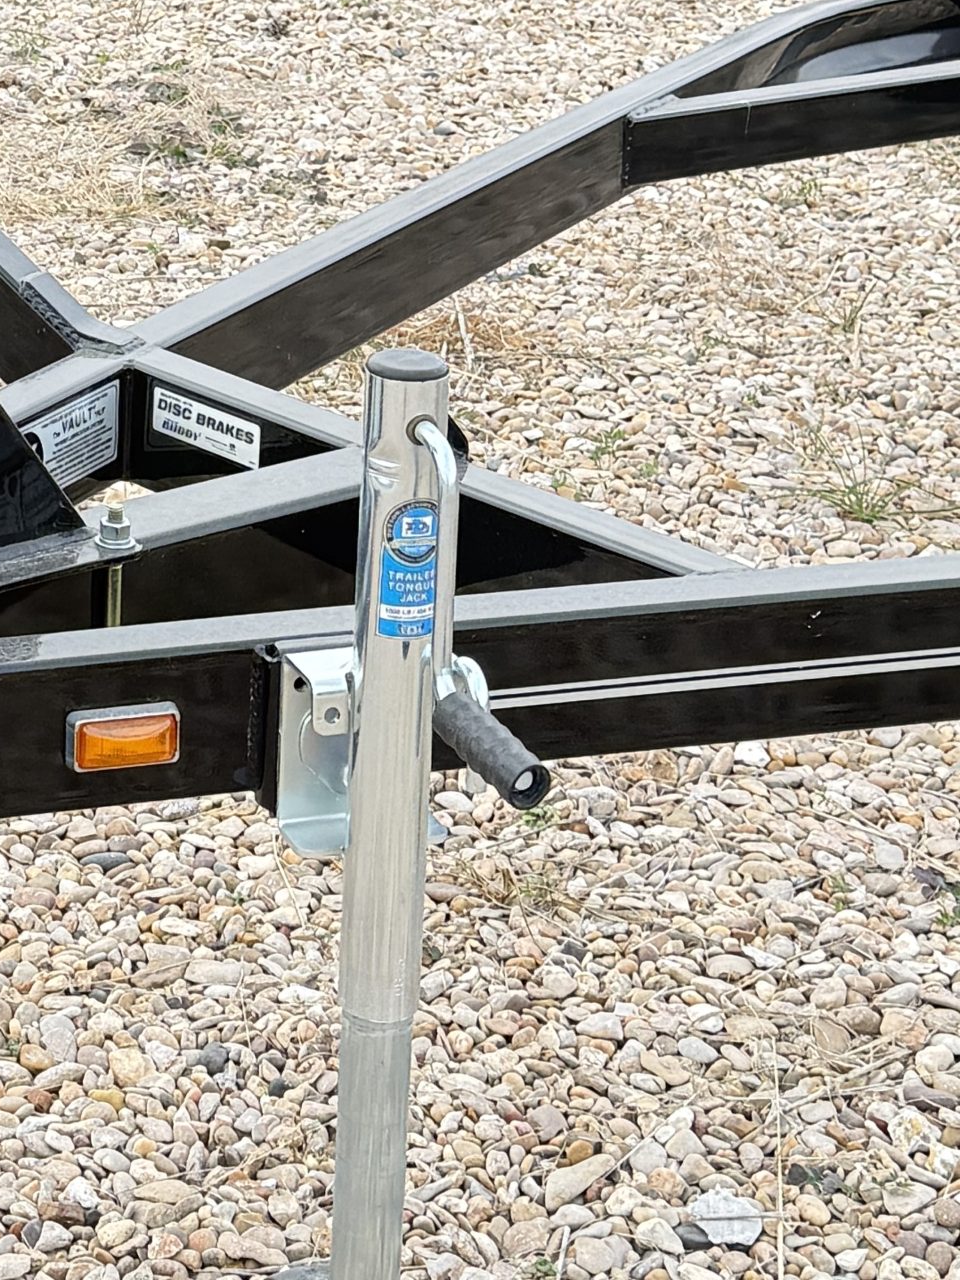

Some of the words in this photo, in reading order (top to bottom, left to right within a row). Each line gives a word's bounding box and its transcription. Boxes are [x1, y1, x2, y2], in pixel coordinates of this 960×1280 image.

[62, 405, 93, 434] VAULT
[157, 398, 192, 421] DISC
[195, 412, 255, 445] BRAKES
[400, 593, 428, 602] JACK
